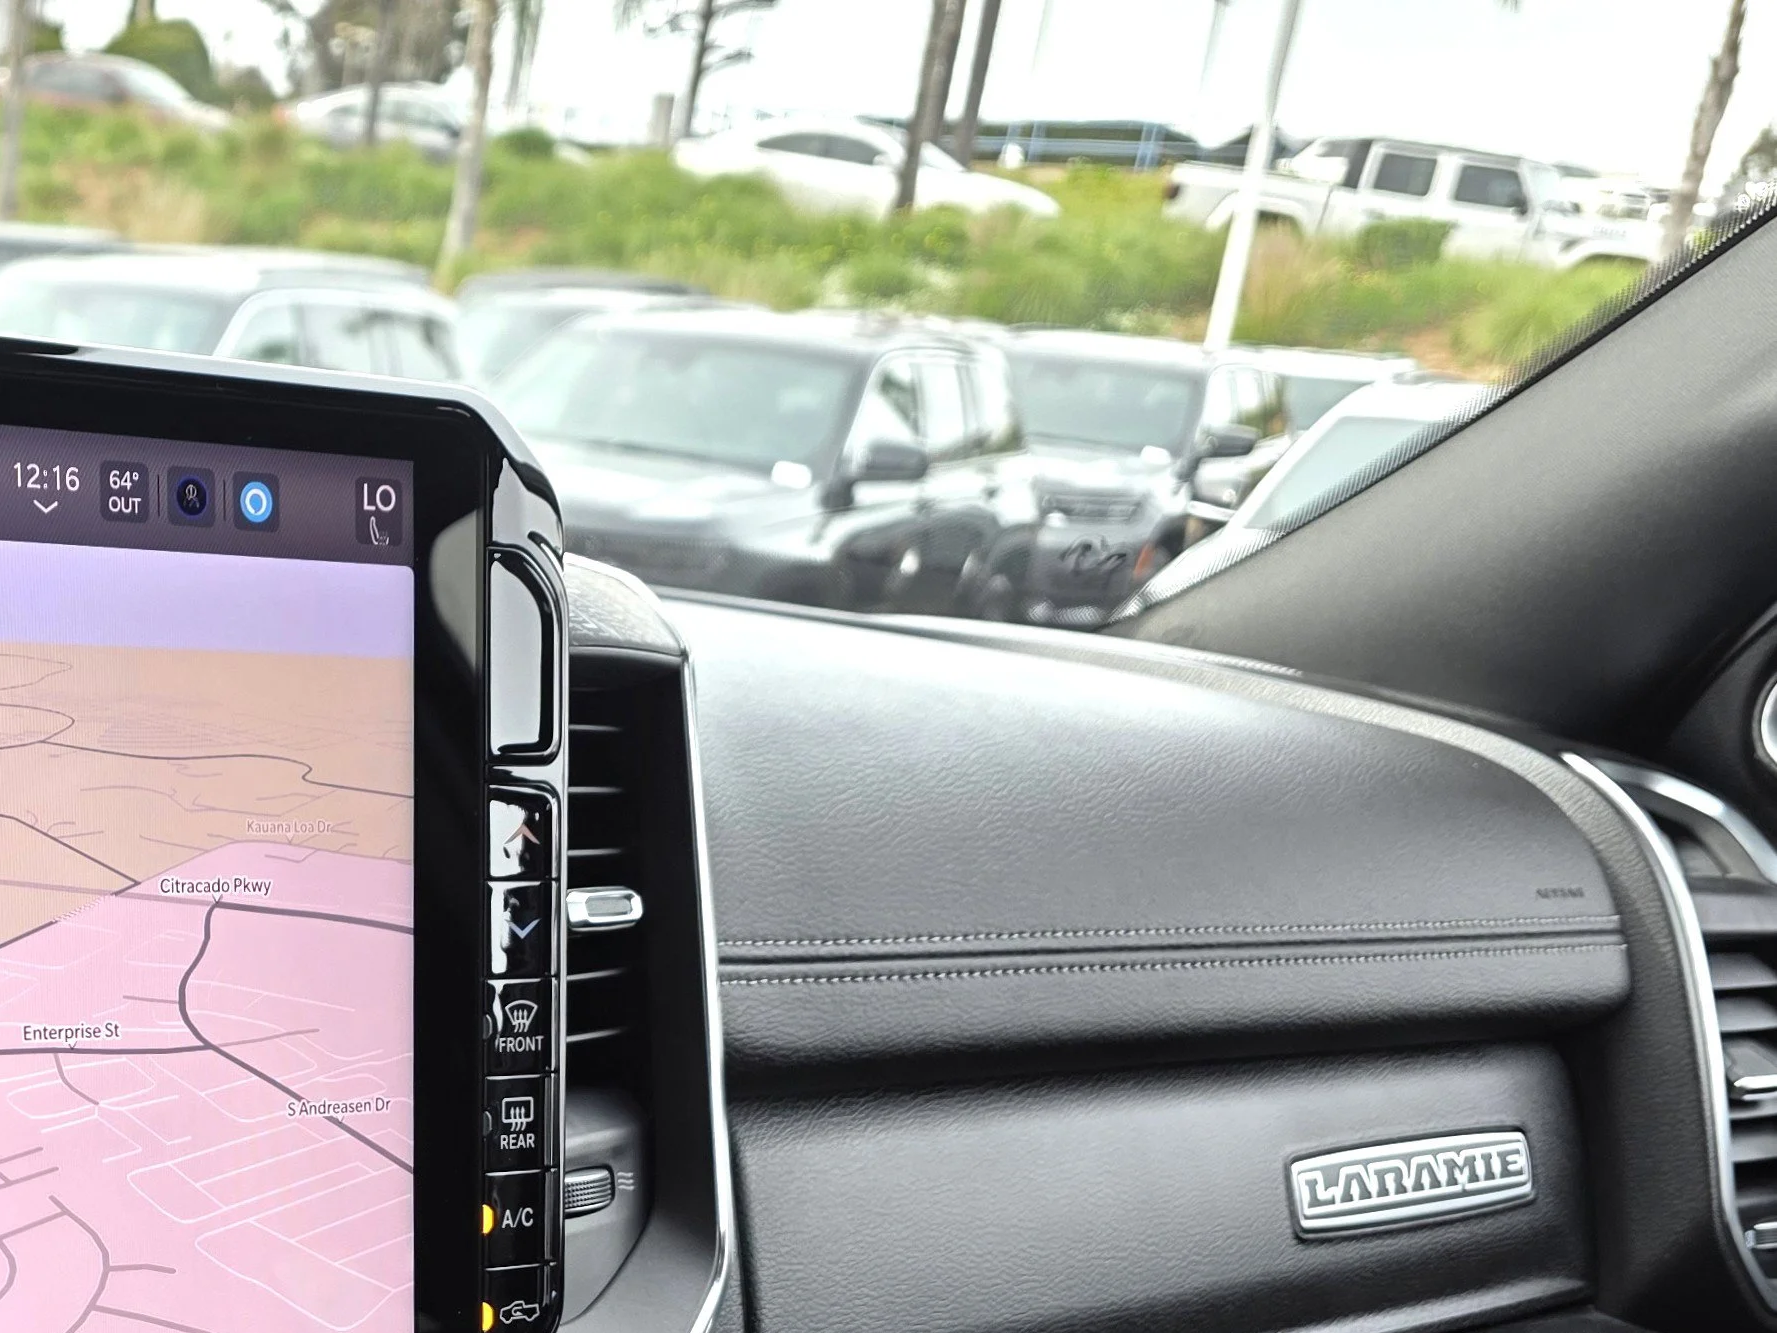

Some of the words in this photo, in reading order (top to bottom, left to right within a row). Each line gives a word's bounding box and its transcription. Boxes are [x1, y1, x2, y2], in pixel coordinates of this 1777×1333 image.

[13, 462, 80, 493] 12:16
[108, 494, 142, 515] OUT
[363, 486, 396, 513] LO
[246, 819, 290, 835] Kauana
[294, 819, 314, 834] Loa
[160, 878, 230, 894] Citracado
[234, 878, 271, 898] Pkwy
[23, 1024, 100, 1044] Enterprise
[102, 1023, 119, 1040] St
[498, 1035, 544, 1054] FRONT
[287, 1102, 295, 1117] S
[298, 1099, 371, 1117] Andreasen
[376, 1097, 390, 1113] Dr
[500, 1134, 535, 1150] REAR
[1302, 1146, 1525, 1212] LARAMIE
[502, 1208, 534, 1228] A/C
